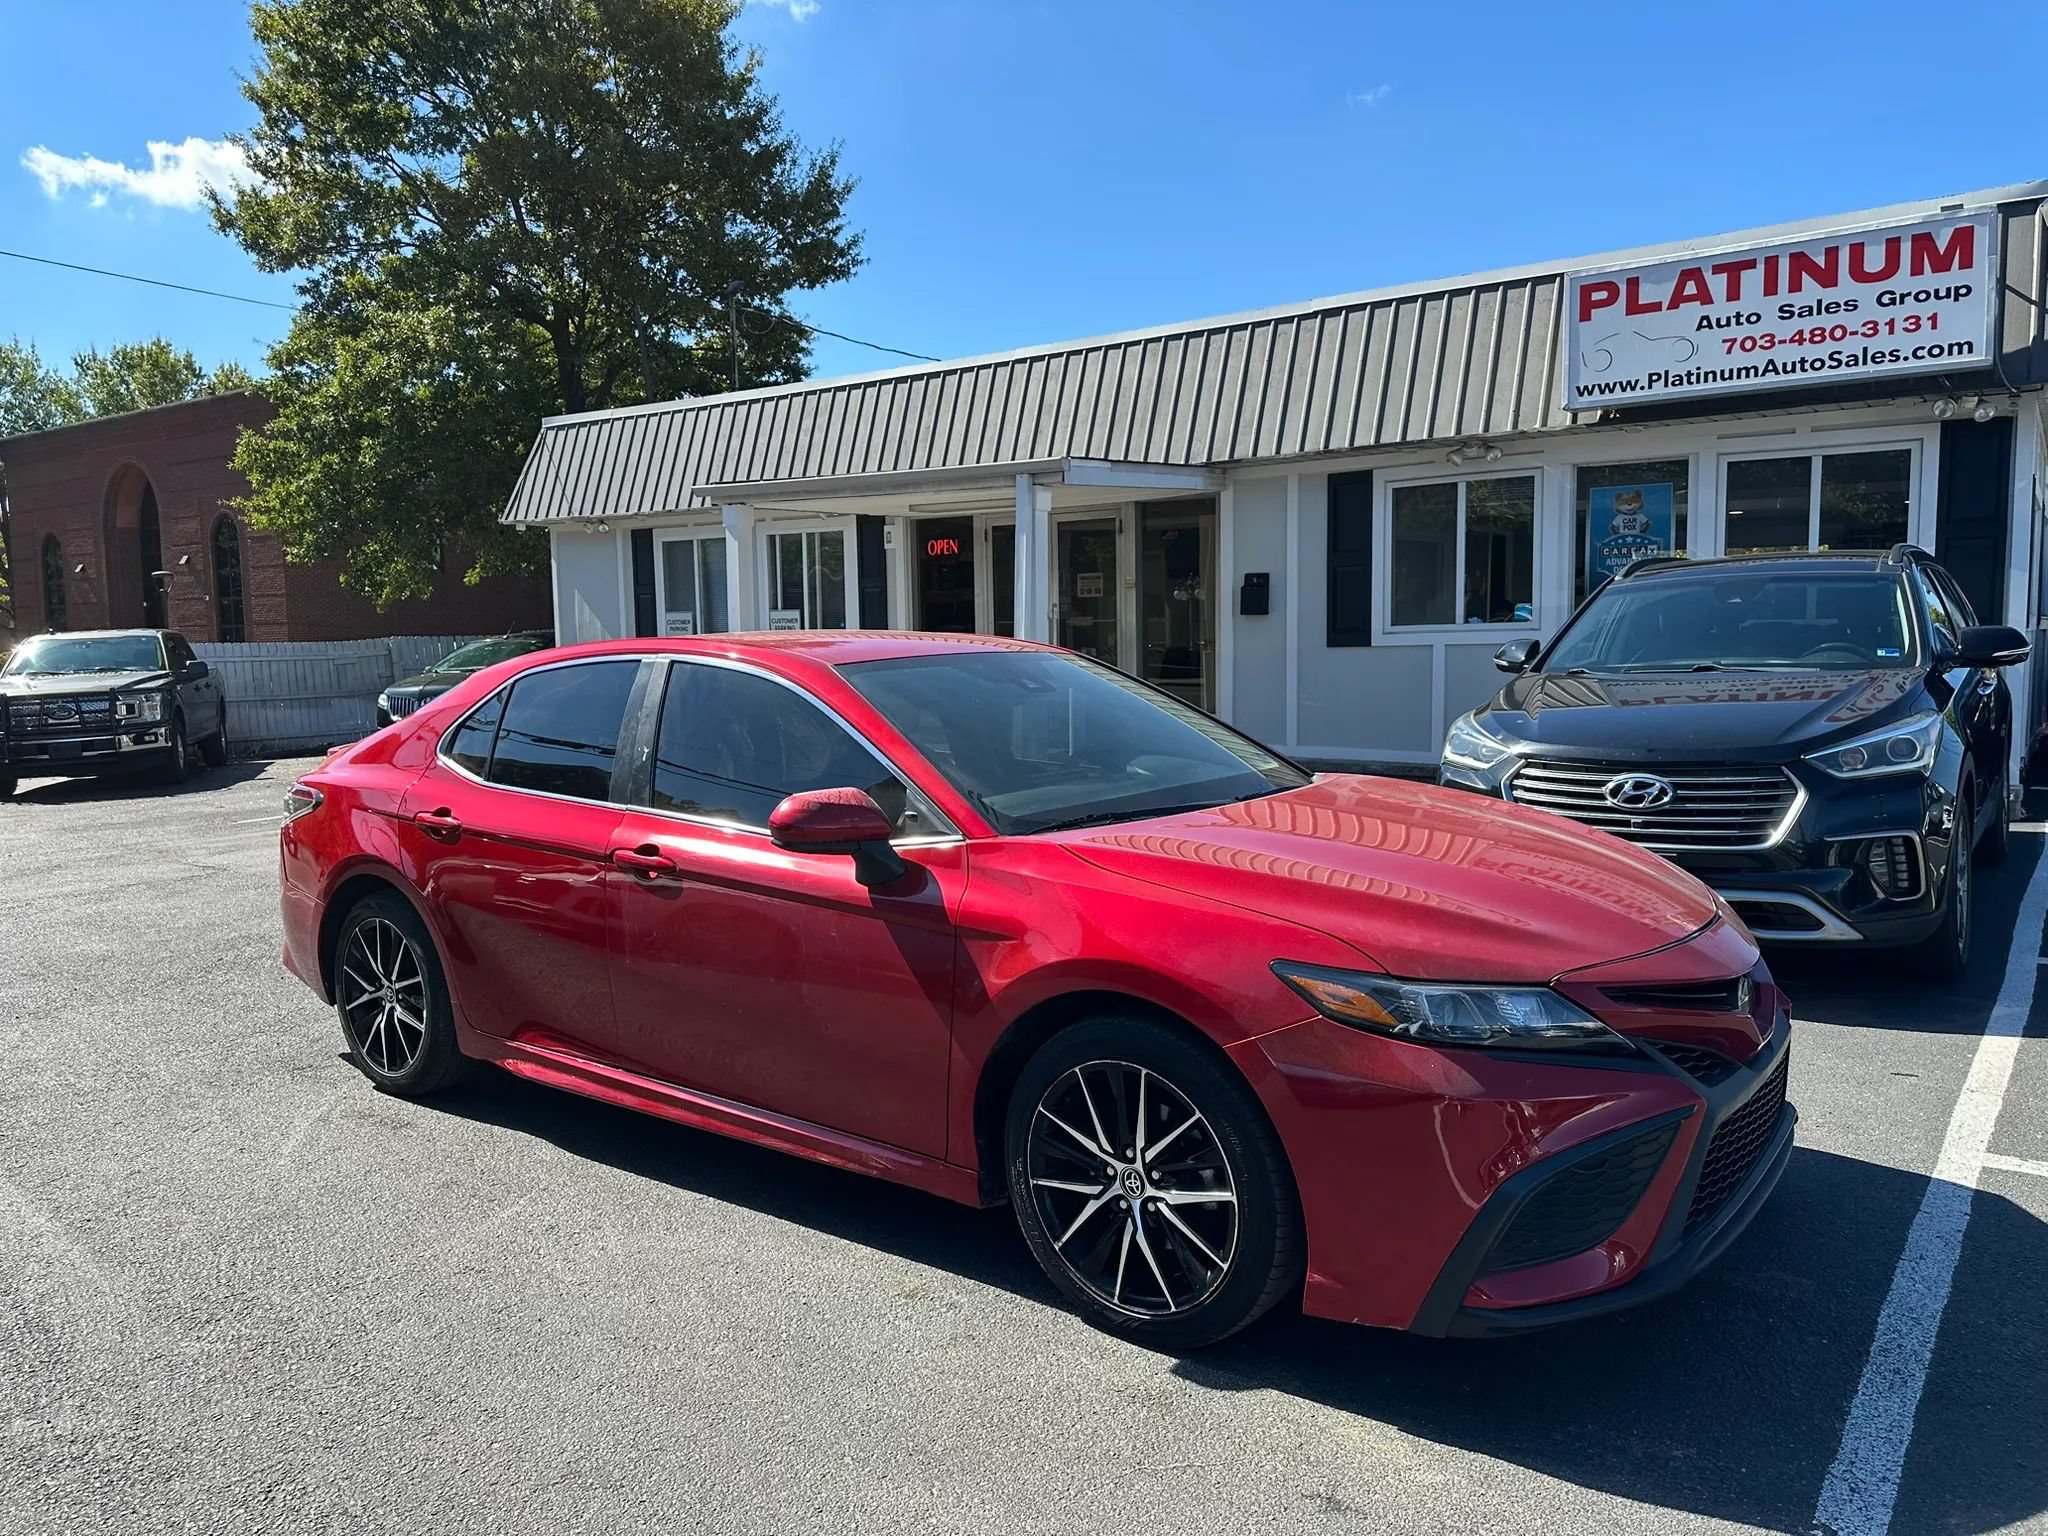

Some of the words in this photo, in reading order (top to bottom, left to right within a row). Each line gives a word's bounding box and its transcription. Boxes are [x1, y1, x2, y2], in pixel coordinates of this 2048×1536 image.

[1578, 225, 1975, 323] PLATINUM
[1695, 311, 1762, 333] Auto
[1777, 298, 1859, 321] Sales
[1875, 282, 1973, 308] Group
[1721, 312, 1939, 355] 703-480-3131
[1575, 338, 1974, 398] www.PlatinumAutoSales.com
[1622, 517, 1638, 525] CAR
[928, 539, 958, 555] OPEN
[1603, 545, 1657, 556] CARFAX
